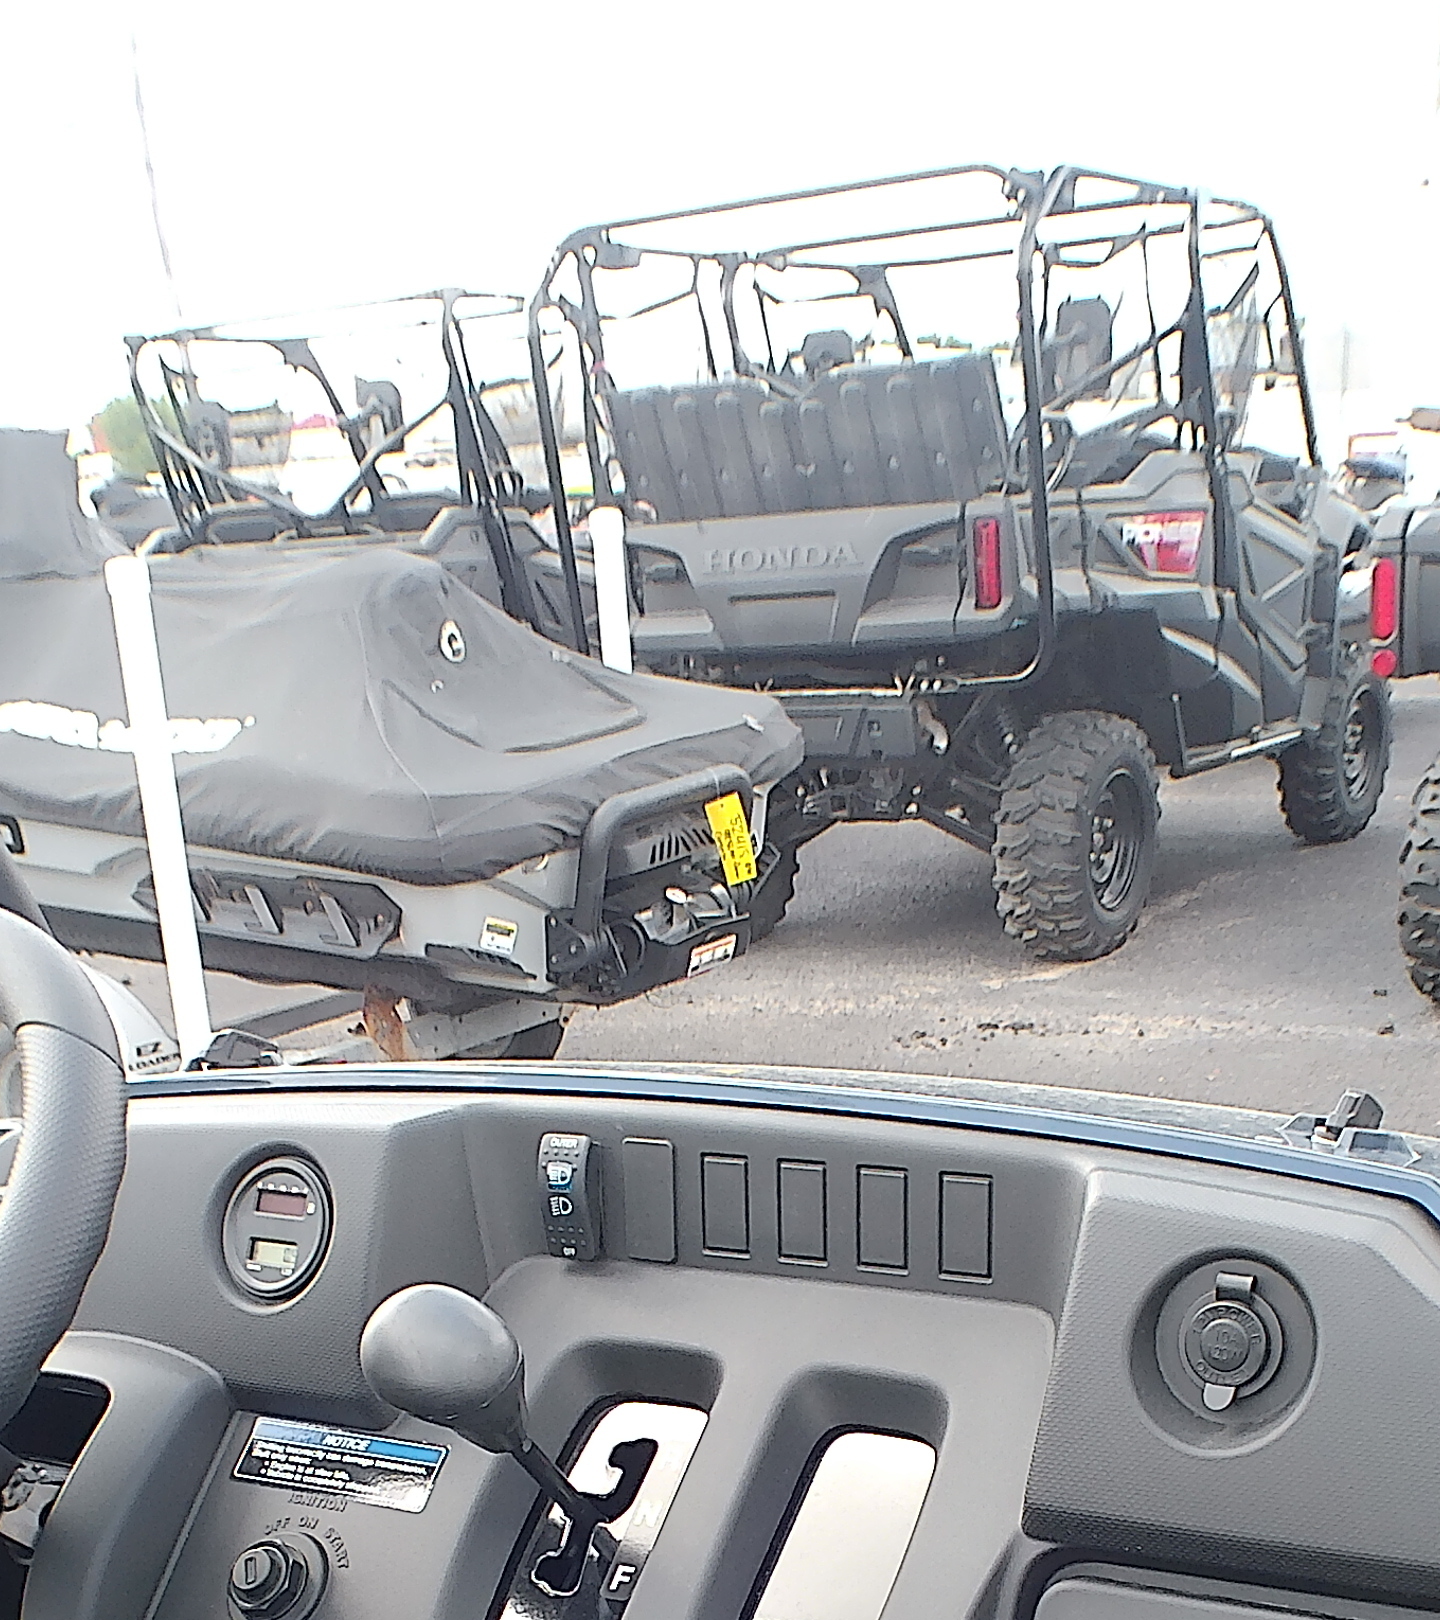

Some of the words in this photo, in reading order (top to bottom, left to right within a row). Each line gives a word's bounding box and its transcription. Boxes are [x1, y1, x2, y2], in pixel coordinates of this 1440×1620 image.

[703, 542, 863, 575] HONDA
[323, 1433, 371, 1451] NOTICE
[288, 1492, 347, 1512] IGNITION
[634, 1499, 664, 1527] N
[264, 1516, 291, 1535] OFF
[298, 1515, 319, 1530] ON
[325, 1525, 350, 1569] START
[610, 1564, 636, 1590] F
